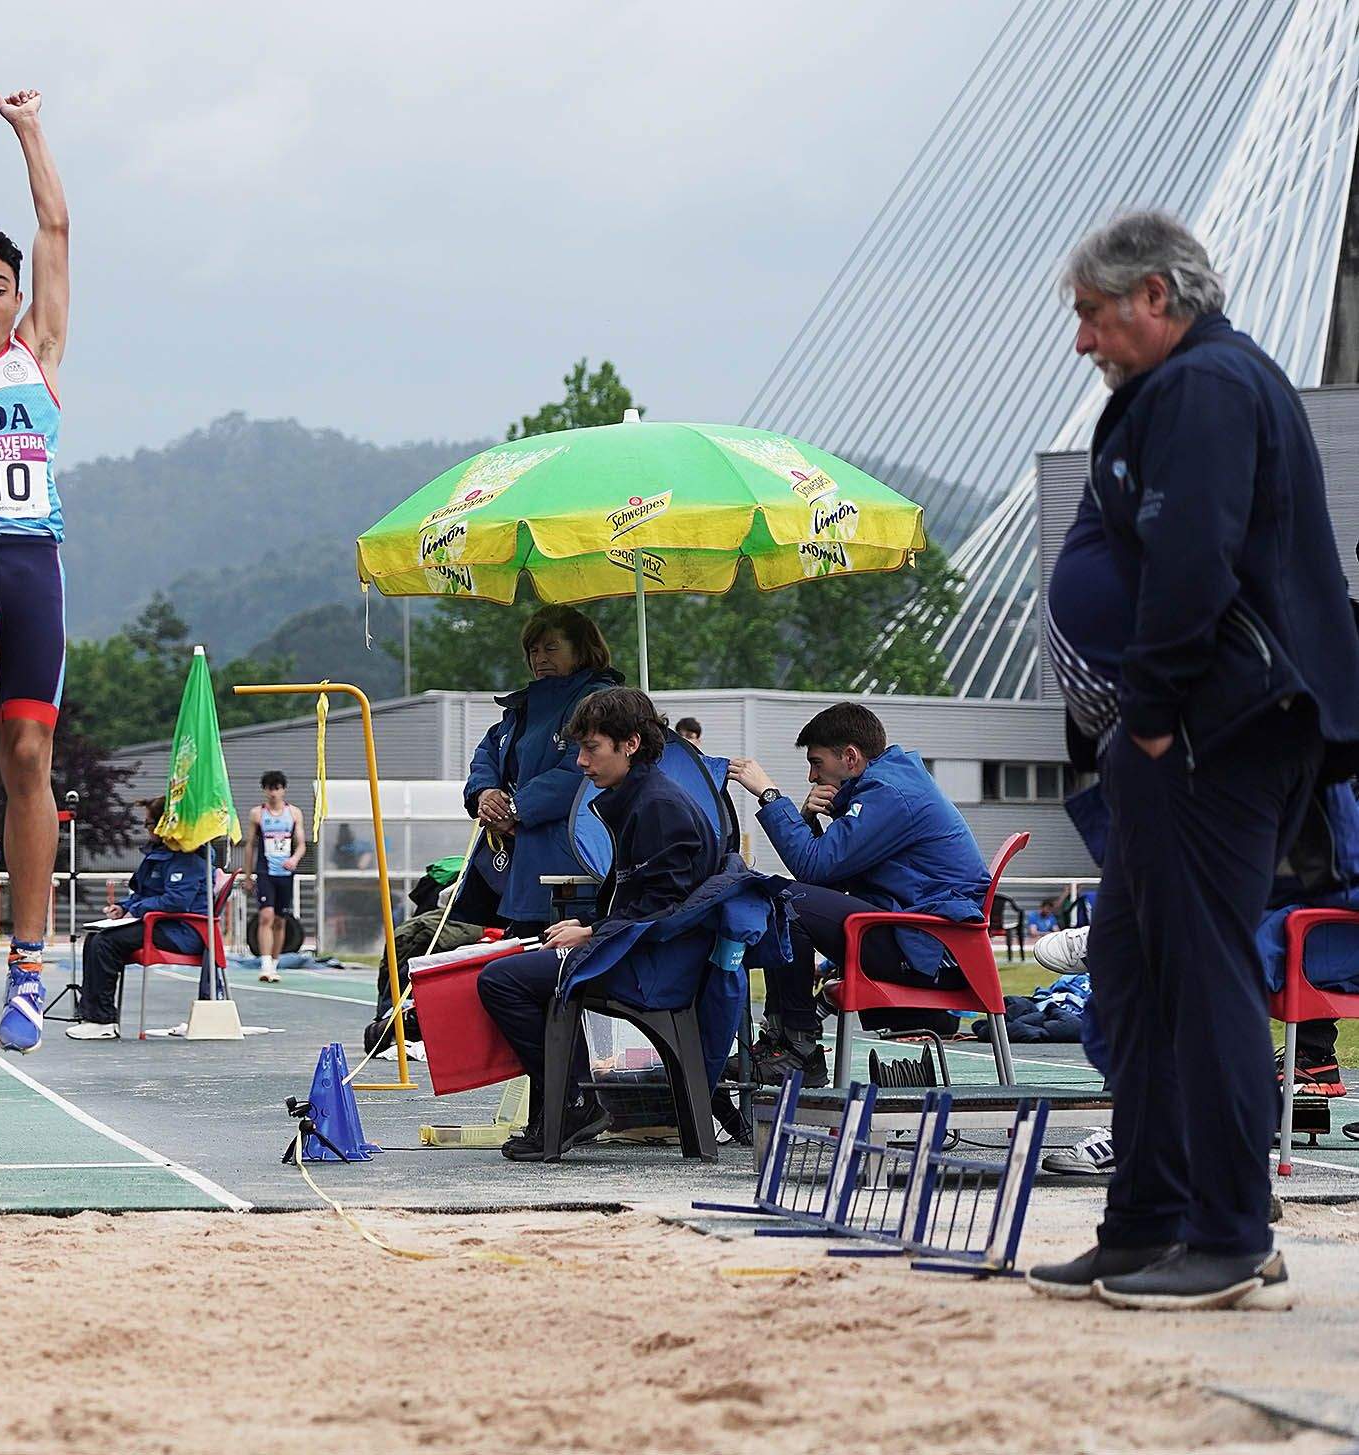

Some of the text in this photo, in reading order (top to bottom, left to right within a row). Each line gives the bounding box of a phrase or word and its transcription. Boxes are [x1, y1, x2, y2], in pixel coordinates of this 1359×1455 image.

[611, 497, 666, 532] Schweppes
[814, 501, 859, 535] limón
[422, 523, 467, 561] limón
